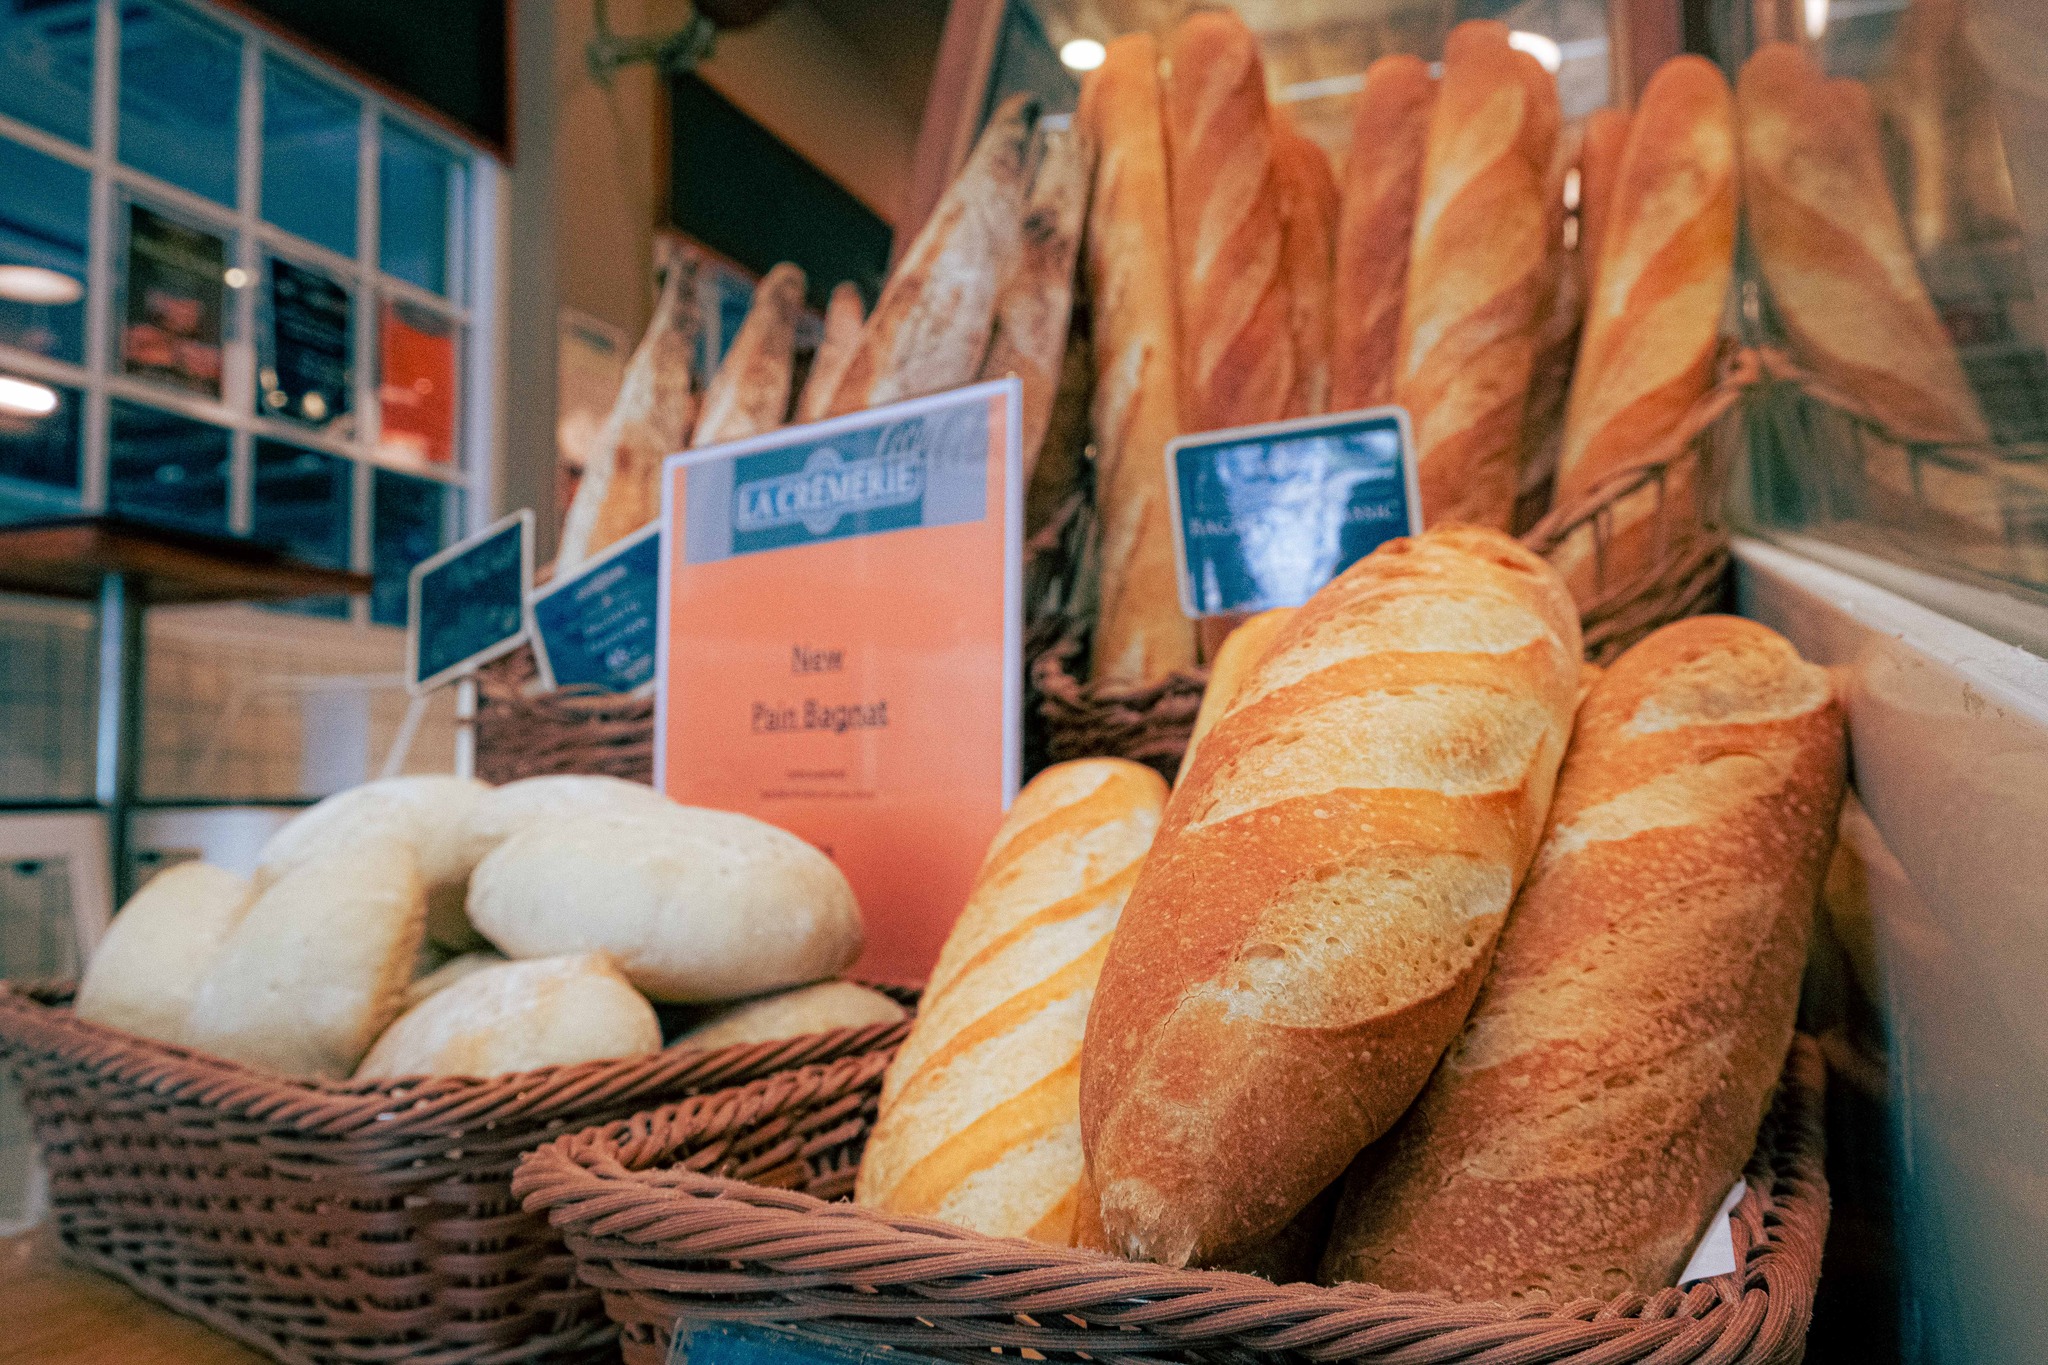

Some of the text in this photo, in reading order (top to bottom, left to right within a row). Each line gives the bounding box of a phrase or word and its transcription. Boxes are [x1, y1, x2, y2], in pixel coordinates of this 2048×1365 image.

[738, 485, 779, 521] LA
[792, 645, 844, 674] New
[752, 698, 889, 735] Pain Bagnat
